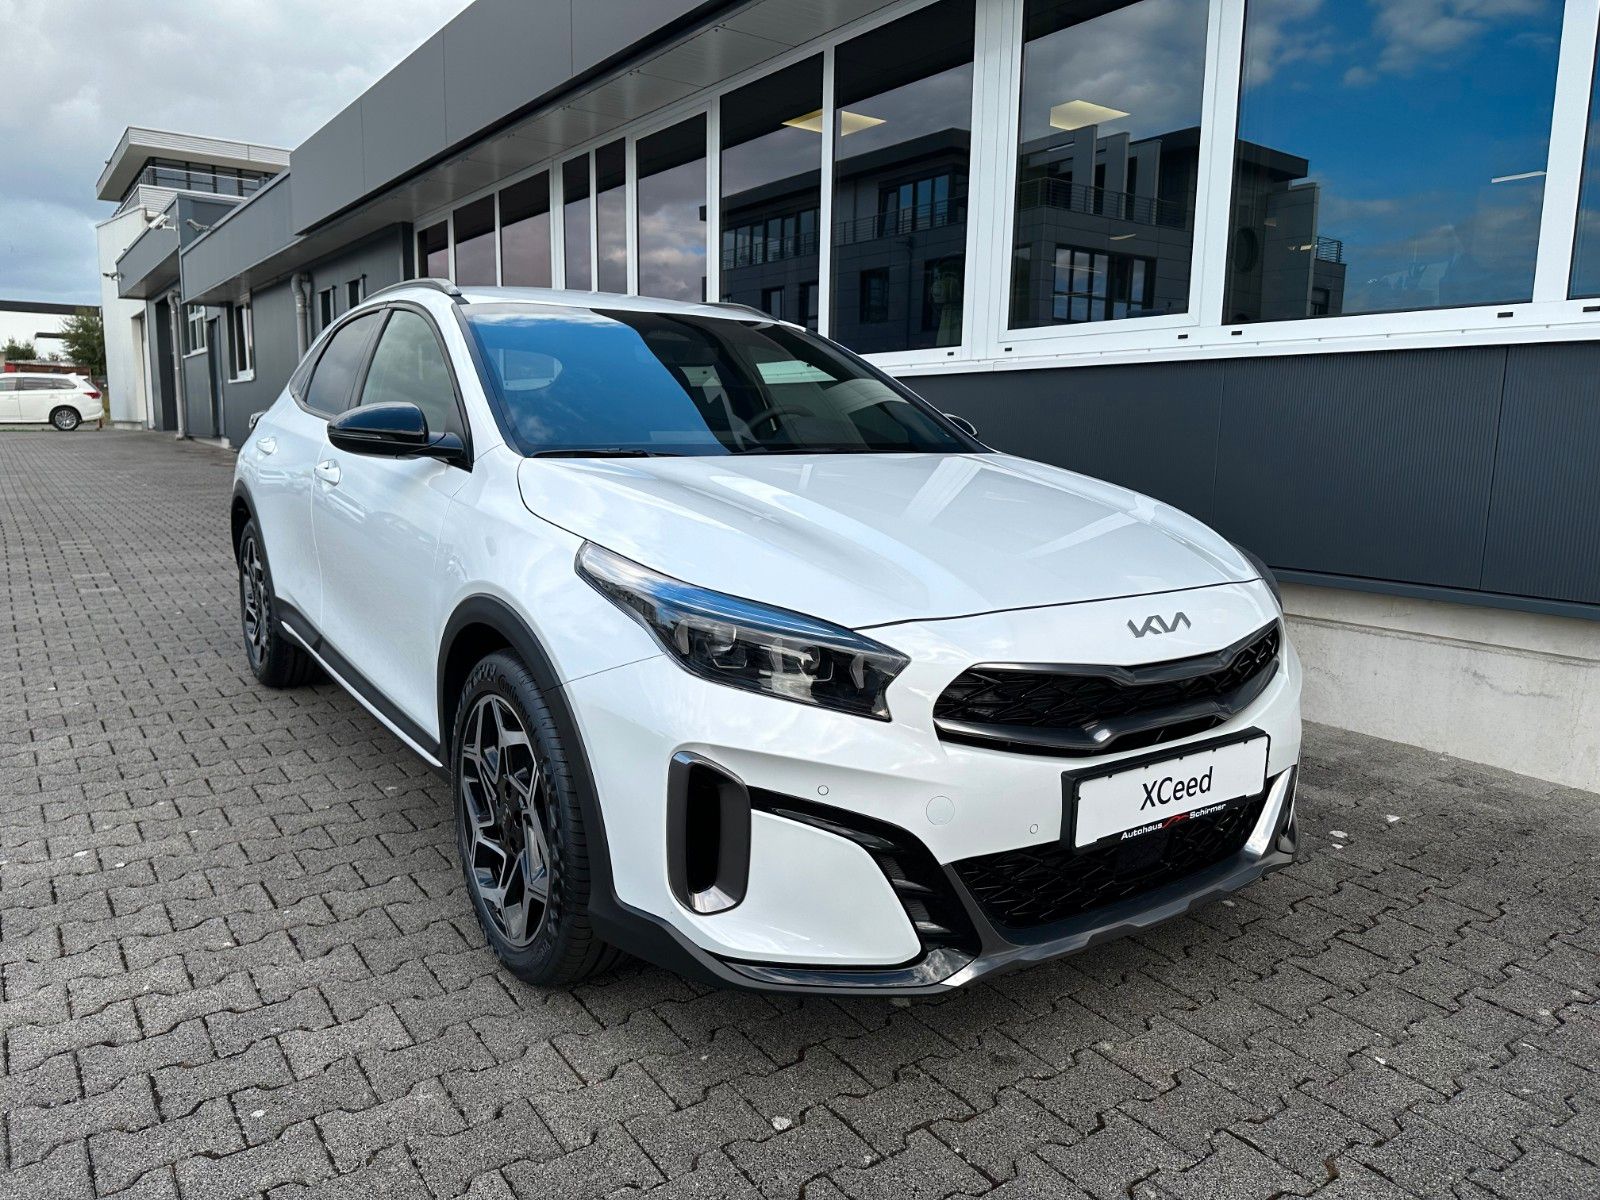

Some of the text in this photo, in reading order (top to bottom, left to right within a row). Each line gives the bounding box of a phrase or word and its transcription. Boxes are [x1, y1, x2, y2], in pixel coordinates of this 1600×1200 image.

[1127, 611, 1192, 638] KIA
[1140, 765, 1214, 811] XCeed
[1120, 803, 1227, 841] Autohaus Schirmer
